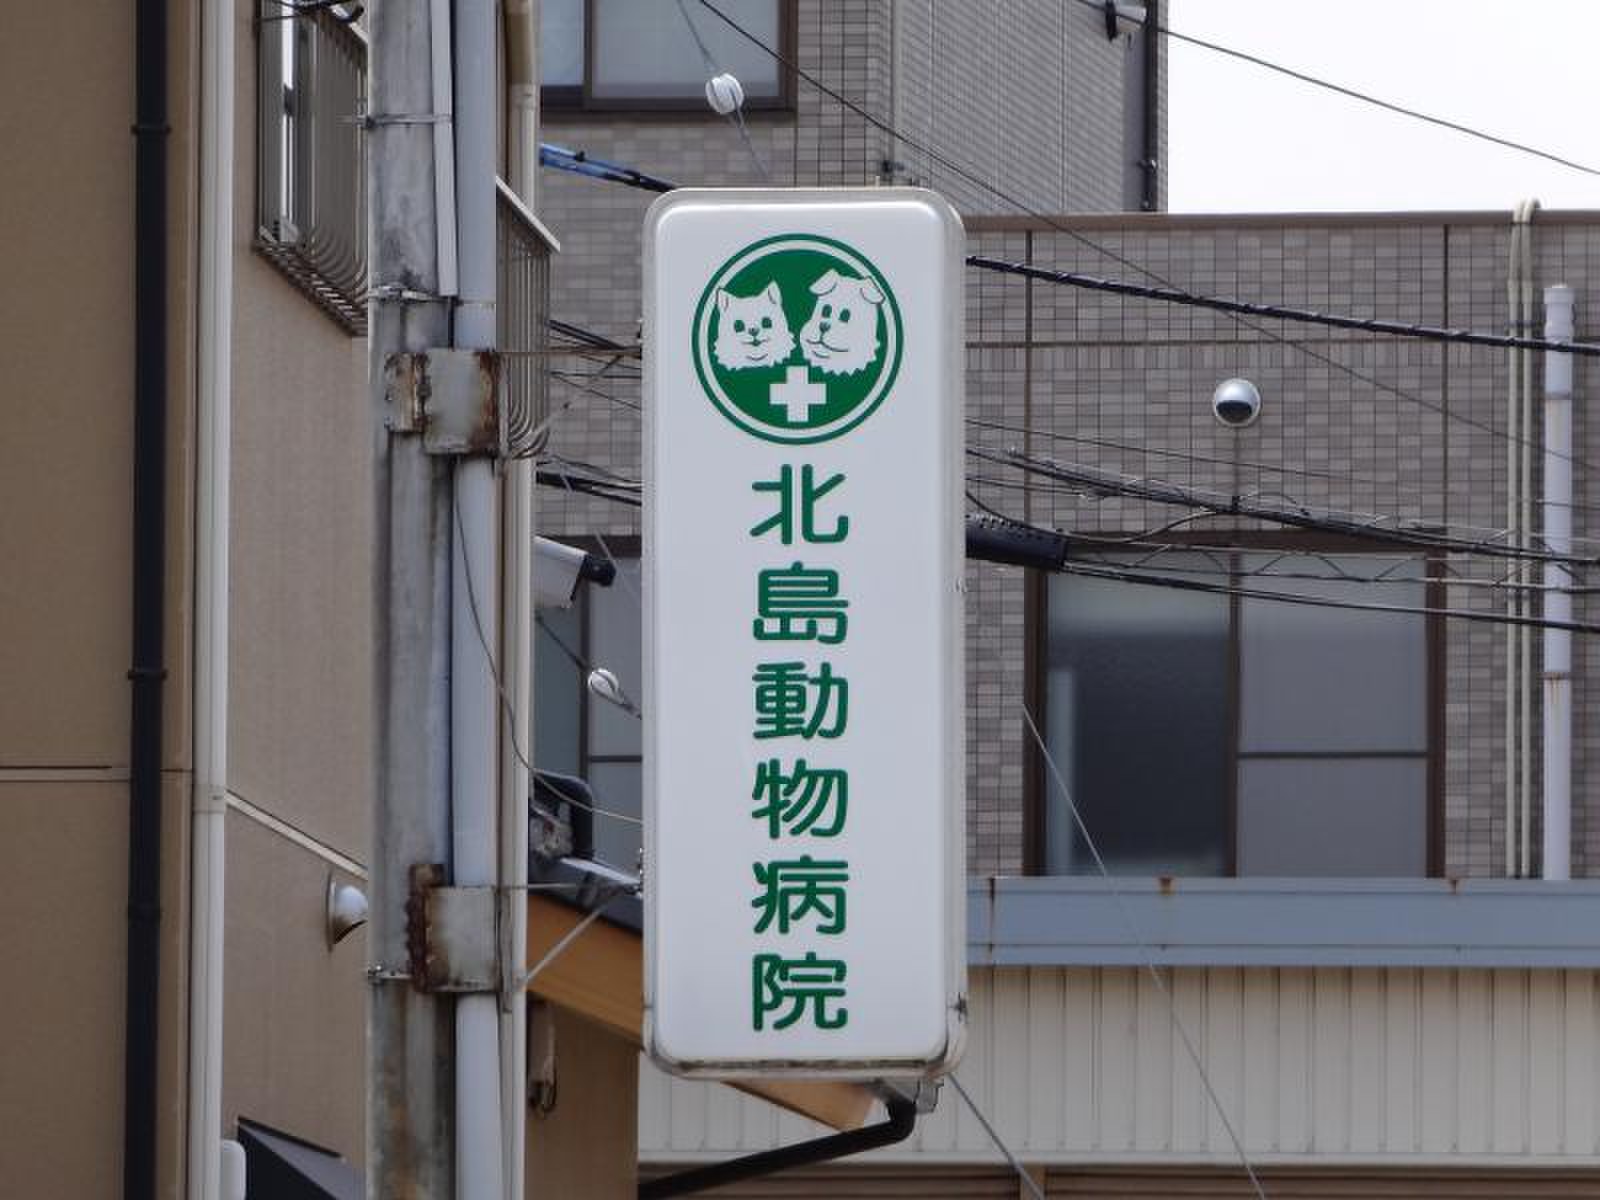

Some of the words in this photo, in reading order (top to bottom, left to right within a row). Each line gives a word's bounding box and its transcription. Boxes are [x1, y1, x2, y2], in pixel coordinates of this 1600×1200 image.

[750, 463, 849, 1031] 北島動物病院
